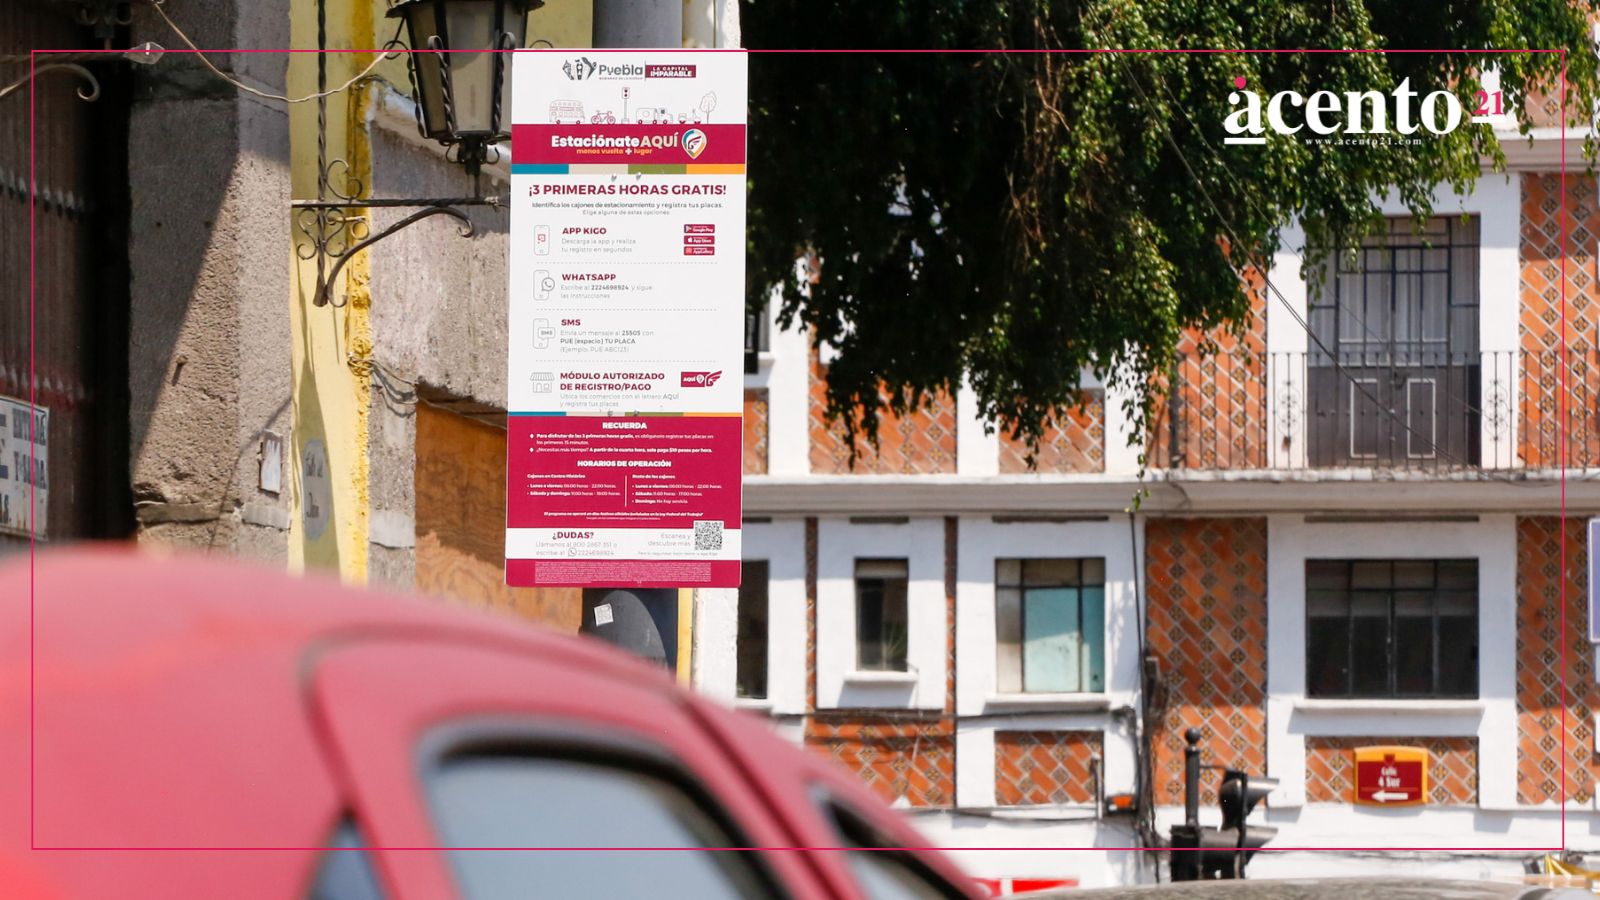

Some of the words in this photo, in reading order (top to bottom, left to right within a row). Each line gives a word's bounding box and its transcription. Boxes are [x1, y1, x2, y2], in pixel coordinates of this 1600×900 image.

[634, 148, 652, 156] lugar
[529, 185, 540, 196] ¡3
[543, 185, 616, 194] PRIMERAS
[619, 185, 668, 194] HORAS
[672, 185, 726, 194] GRATIS!
[560, 371, 600, 379] MÓDULO
[552, 532, 594, 540] ¿DUDAS?
